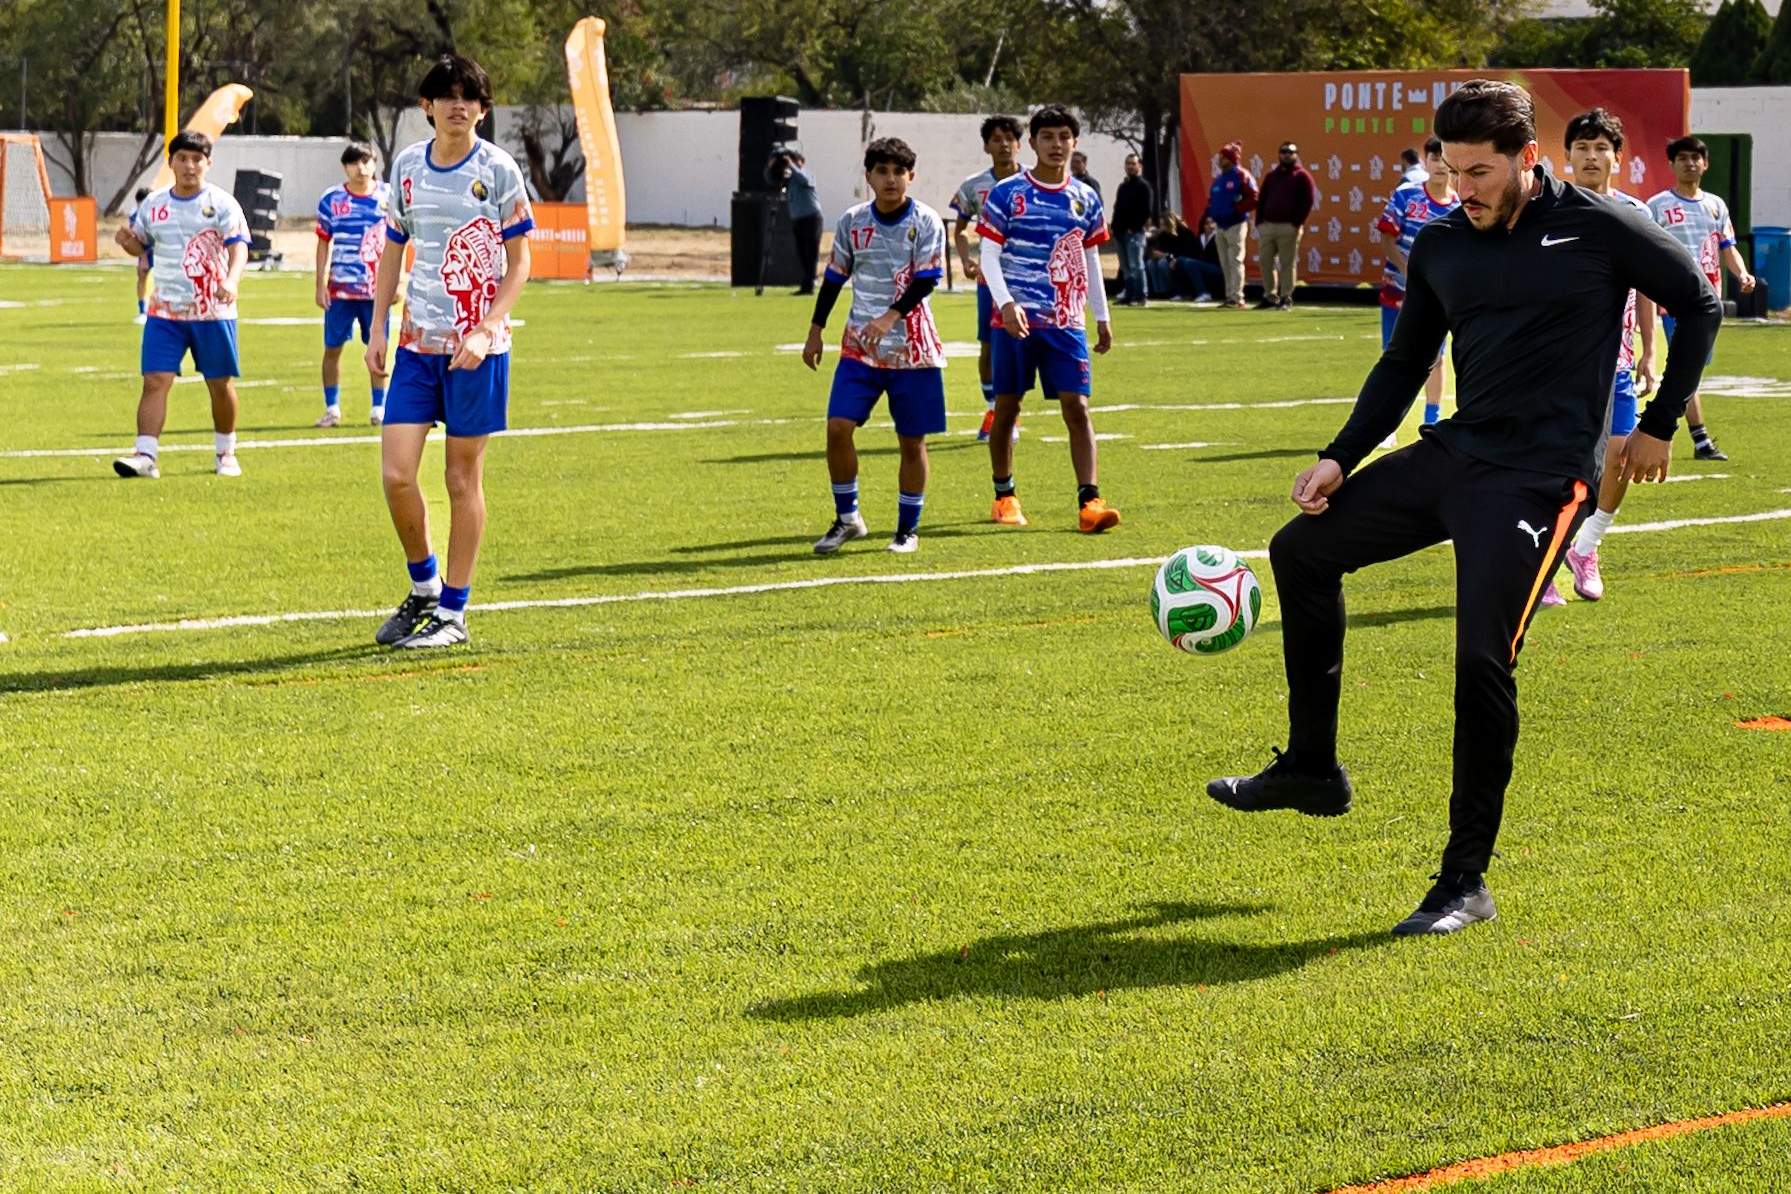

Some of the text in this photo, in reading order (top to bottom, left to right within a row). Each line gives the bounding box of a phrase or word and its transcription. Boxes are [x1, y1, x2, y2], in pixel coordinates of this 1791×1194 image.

[1324, 82, 1402, 110] PONTE
[1324, 117, 1395, 134] PONTE
[332, 202, 350, 216] 16
[1012, 193, 1027, 216] 3
[1407, 202, 1427, 219] 22
[151, 205, 169, 223] 16
[1664, 207, 1684, 224] 15
[851, 227, 875, 250] 17
